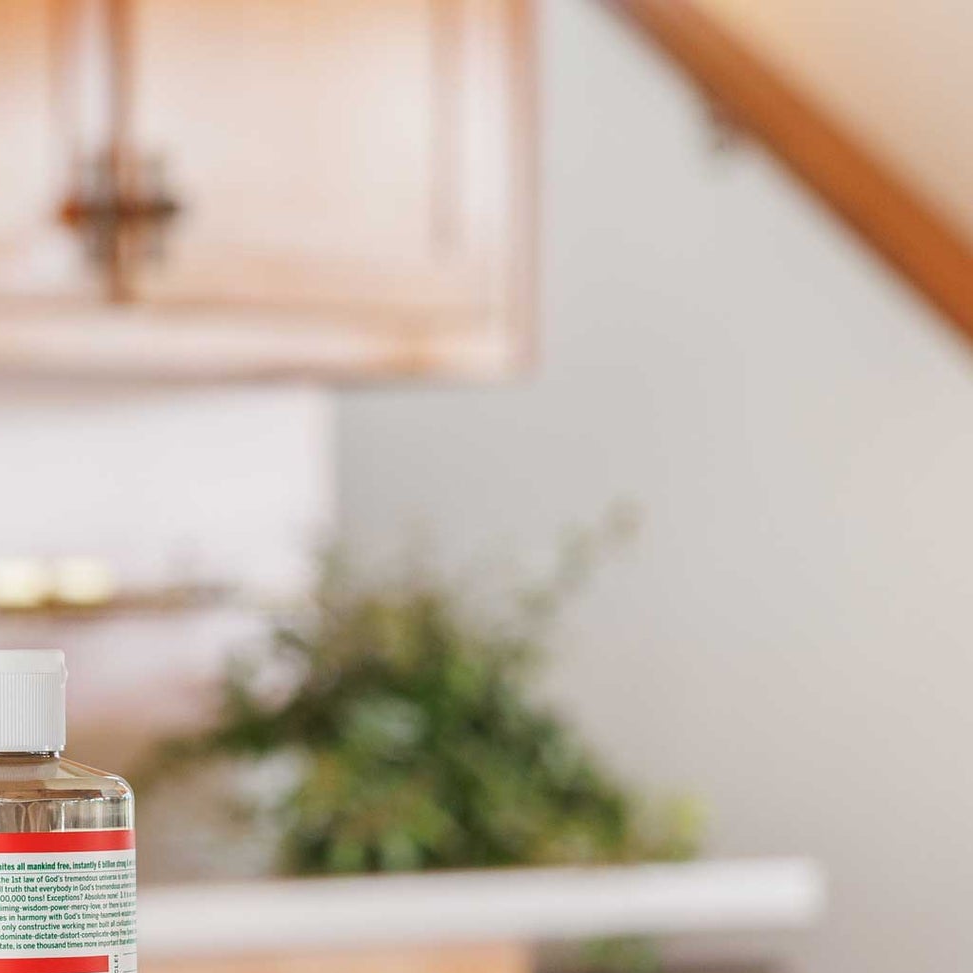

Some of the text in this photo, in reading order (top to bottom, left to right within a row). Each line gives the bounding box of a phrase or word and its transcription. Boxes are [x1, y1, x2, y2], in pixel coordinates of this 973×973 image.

[73, 861, 96, 869] instantly
[65, 874, 97, 882] tremendous
[39, 885, 71, 893] everybody
[47, 894, 83, 902] Exceptions?
[17, 914, 47, 922] harmony
